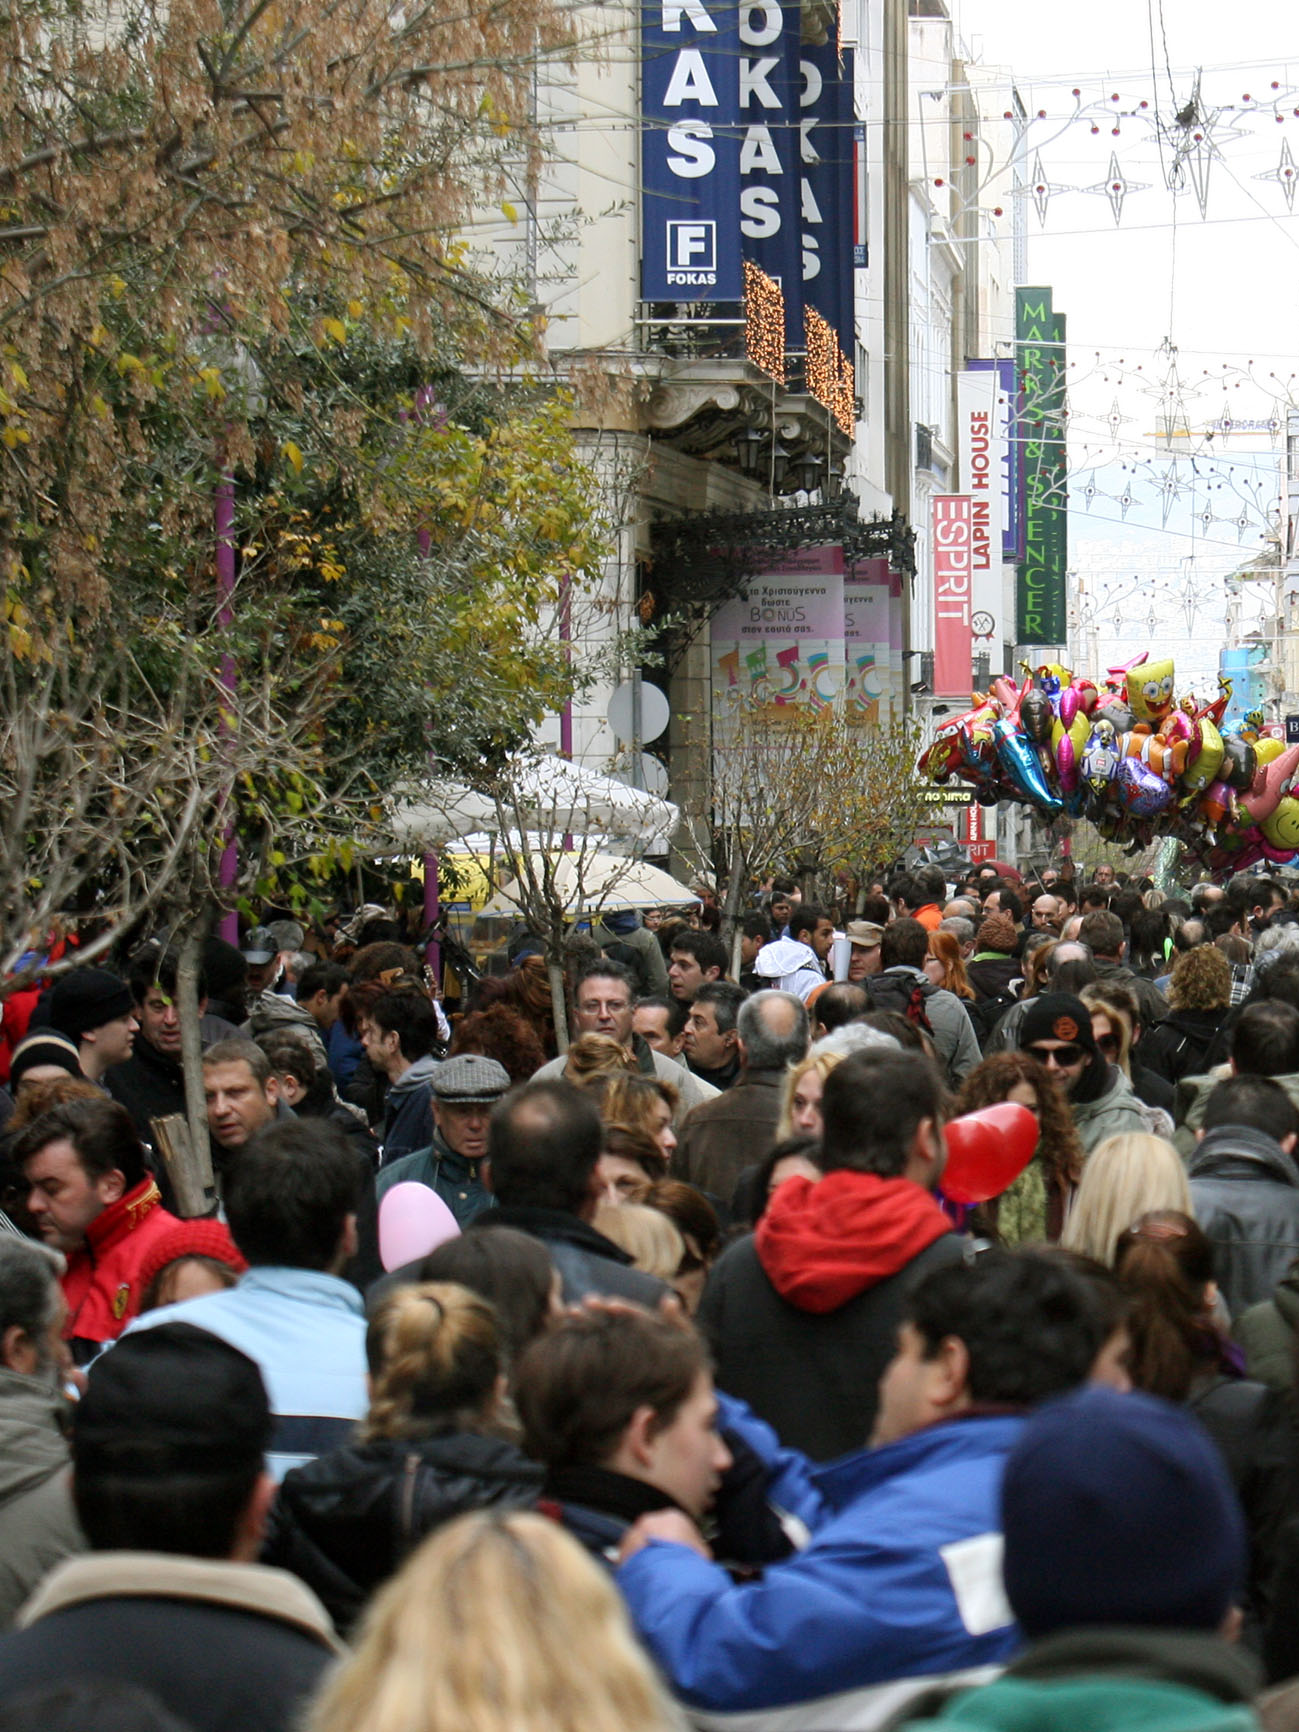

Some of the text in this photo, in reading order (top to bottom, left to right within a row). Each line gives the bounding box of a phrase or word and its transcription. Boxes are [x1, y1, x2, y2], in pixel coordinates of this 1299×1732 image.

[667, 272, 718, 285] FOKAS
[971, 411, 990, 570] LAPIN HOUSE
[1022, 302, 1047, 635] MARKS & SPENCER
[937, 502, 969, 626] ESPRIT
